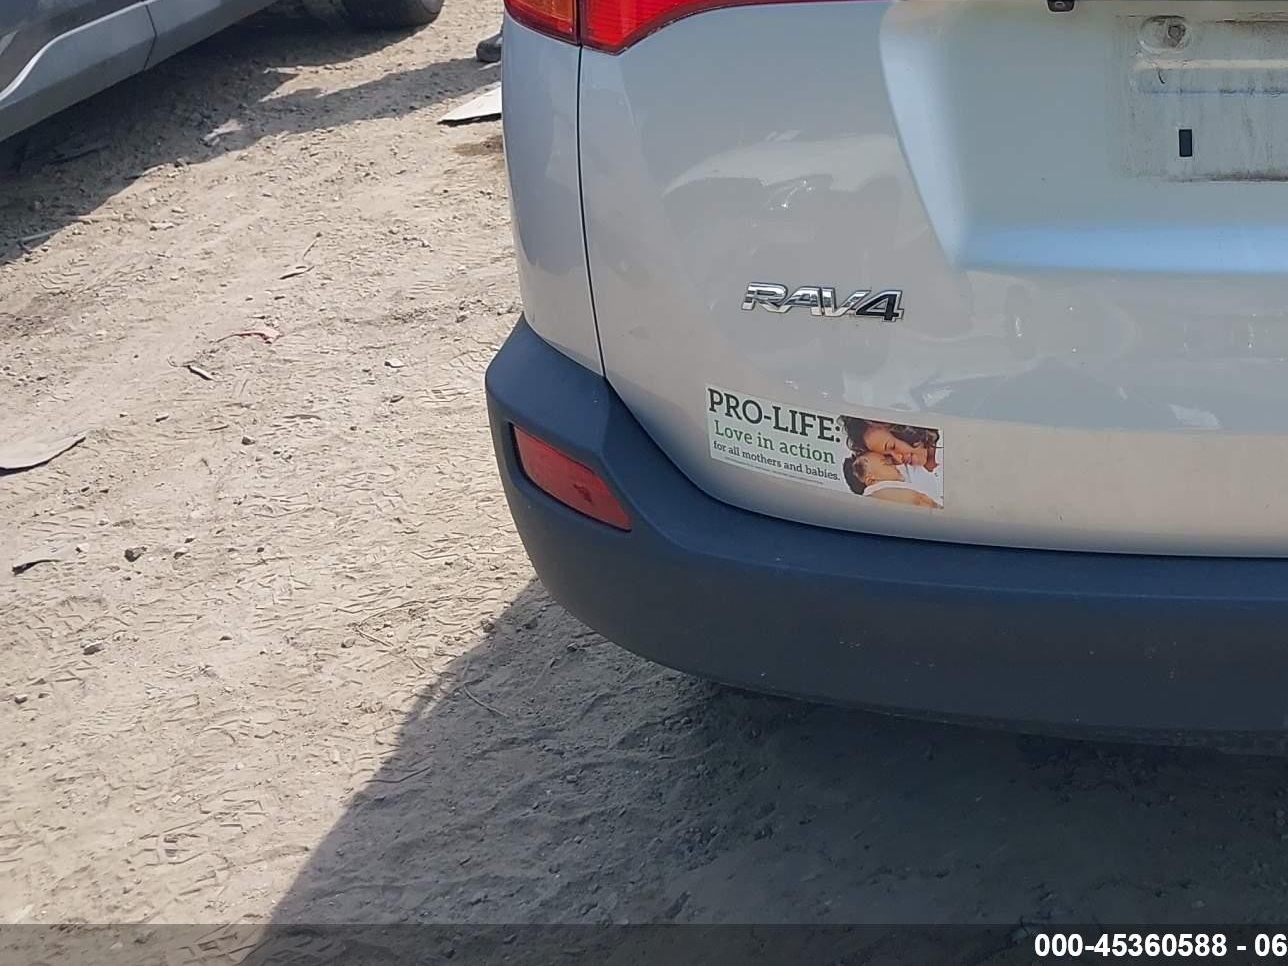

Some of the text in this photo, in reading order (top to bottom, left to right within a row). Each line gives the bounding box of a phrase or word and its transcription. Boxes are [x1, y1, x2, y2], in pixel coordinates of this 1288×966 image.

[741, 281, 905, 322] RAV4
[708, 387, 842, 443] PRO-LIFE:
[713, 440, 726, 451] for
[728, 445, 740, 457] all
[742, 450, 782, 468] mothers
[783, 461, 803, 472] and
[806, 465, 841, 481] babies.
[714, 420, 836, 464] Love in action
